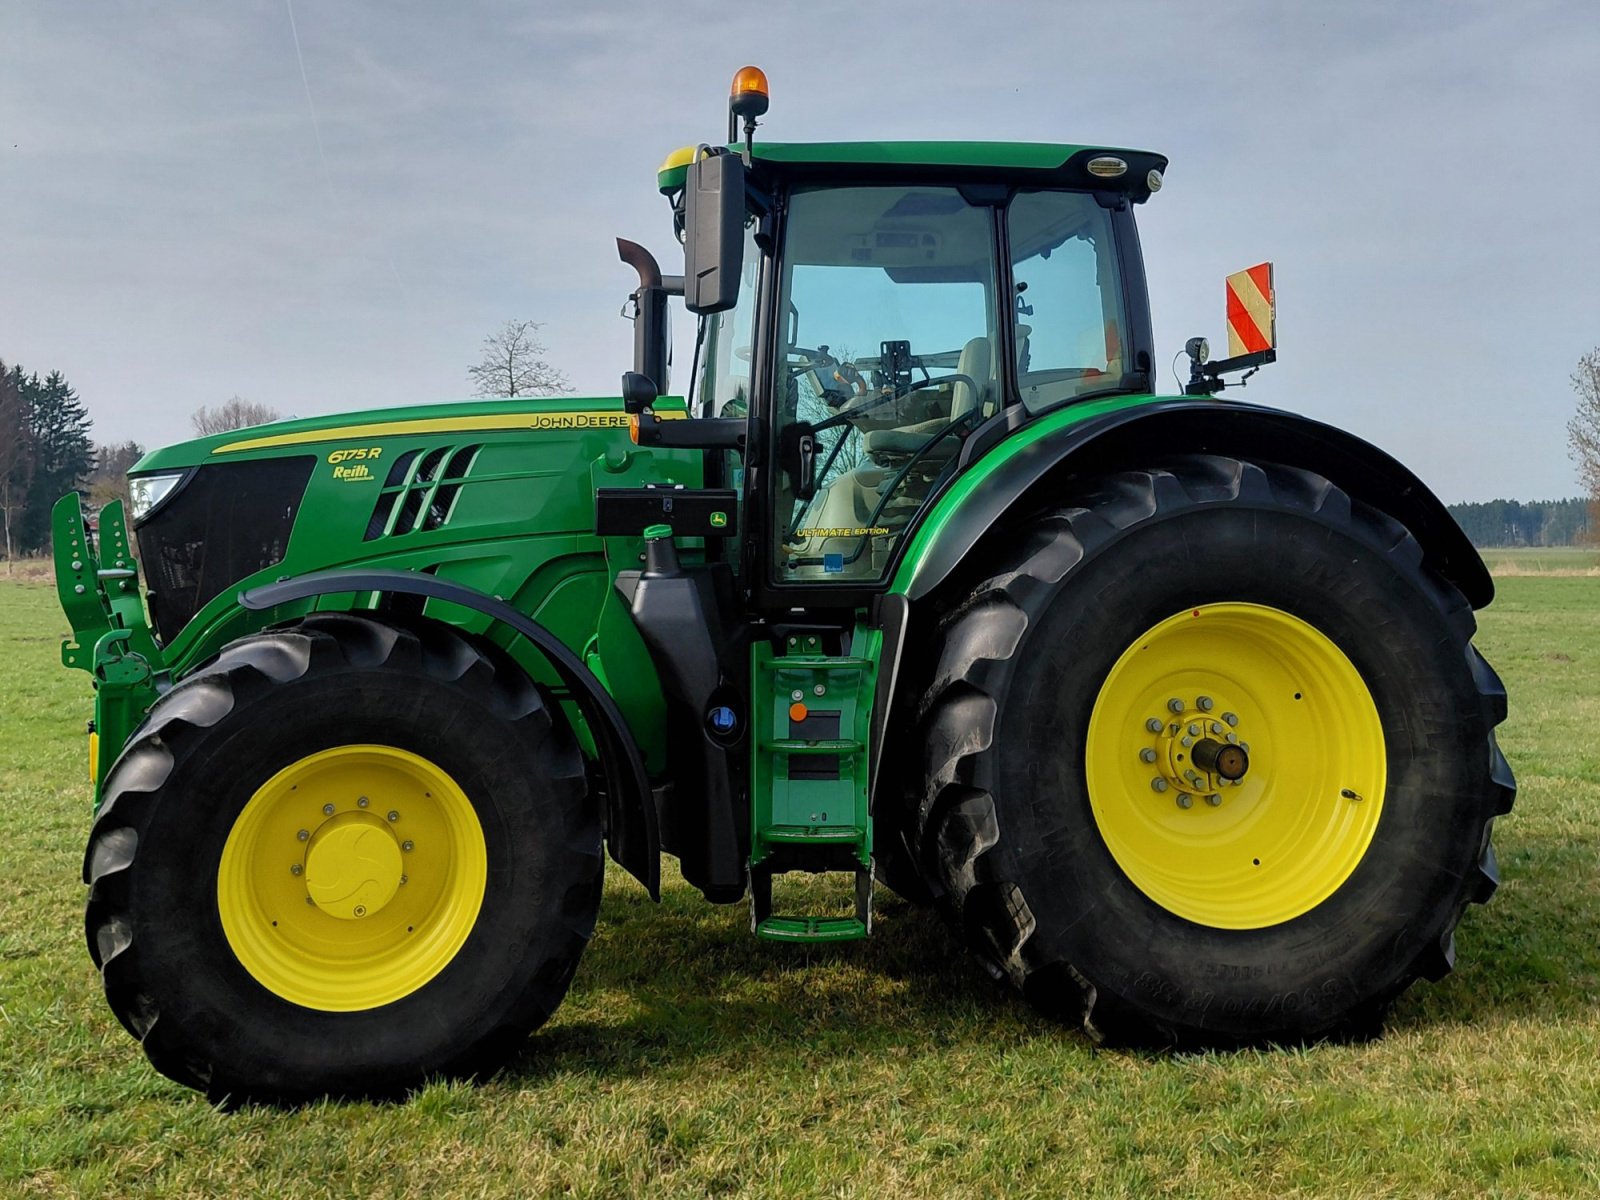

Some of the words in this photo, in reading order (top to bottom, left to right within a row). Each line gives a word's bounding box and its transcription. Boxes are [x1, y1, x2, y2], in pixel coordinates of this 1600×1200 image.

[530, 415, 574, 428] JOHN
[576, 414, 628, 427] DEERE
[332, 464, 370, 479] Reith
[796, 527, 851, 537] ULTIMATE
[854, 526, 890, 535] EDITION
